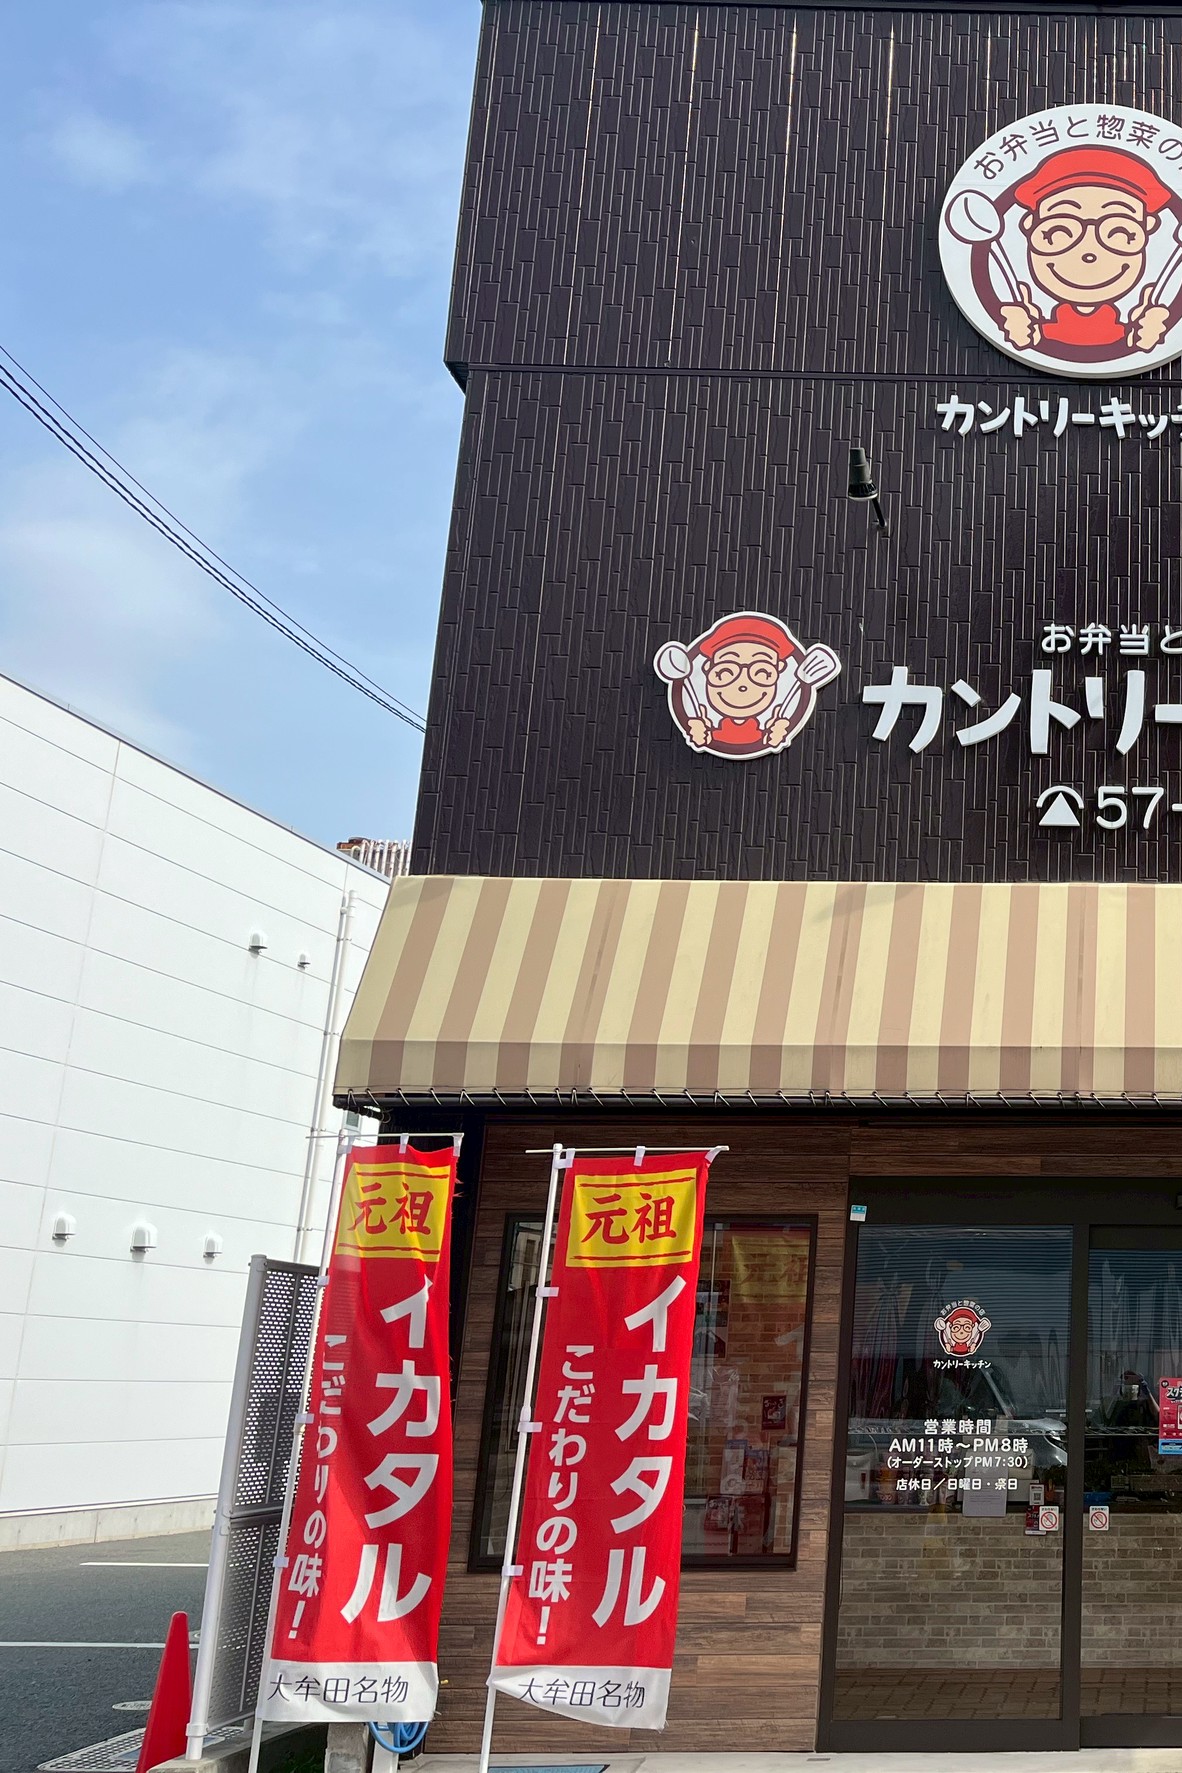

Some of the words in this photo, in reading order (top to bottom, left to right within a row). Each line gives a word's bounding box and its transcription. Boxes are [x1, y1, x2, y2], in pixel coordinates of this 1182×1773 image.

[347, 1182, 434, 1235] 元祖
[581, 1192, 678, 1245] 元祖
[932, 1359, 992, 1370] カントリーキッチン
[340, 1274, 441, 1624] イカタル
[592, 1275, 687, 1628] イカタル
[924, 1419, 992, 1435] 営業時間
[528, 1345, 595, 1645] こだわりの味!
[267, 1673, 409, 1704] 大牟田名物
[518, 1677, 646, 1708] 大牟田名物
